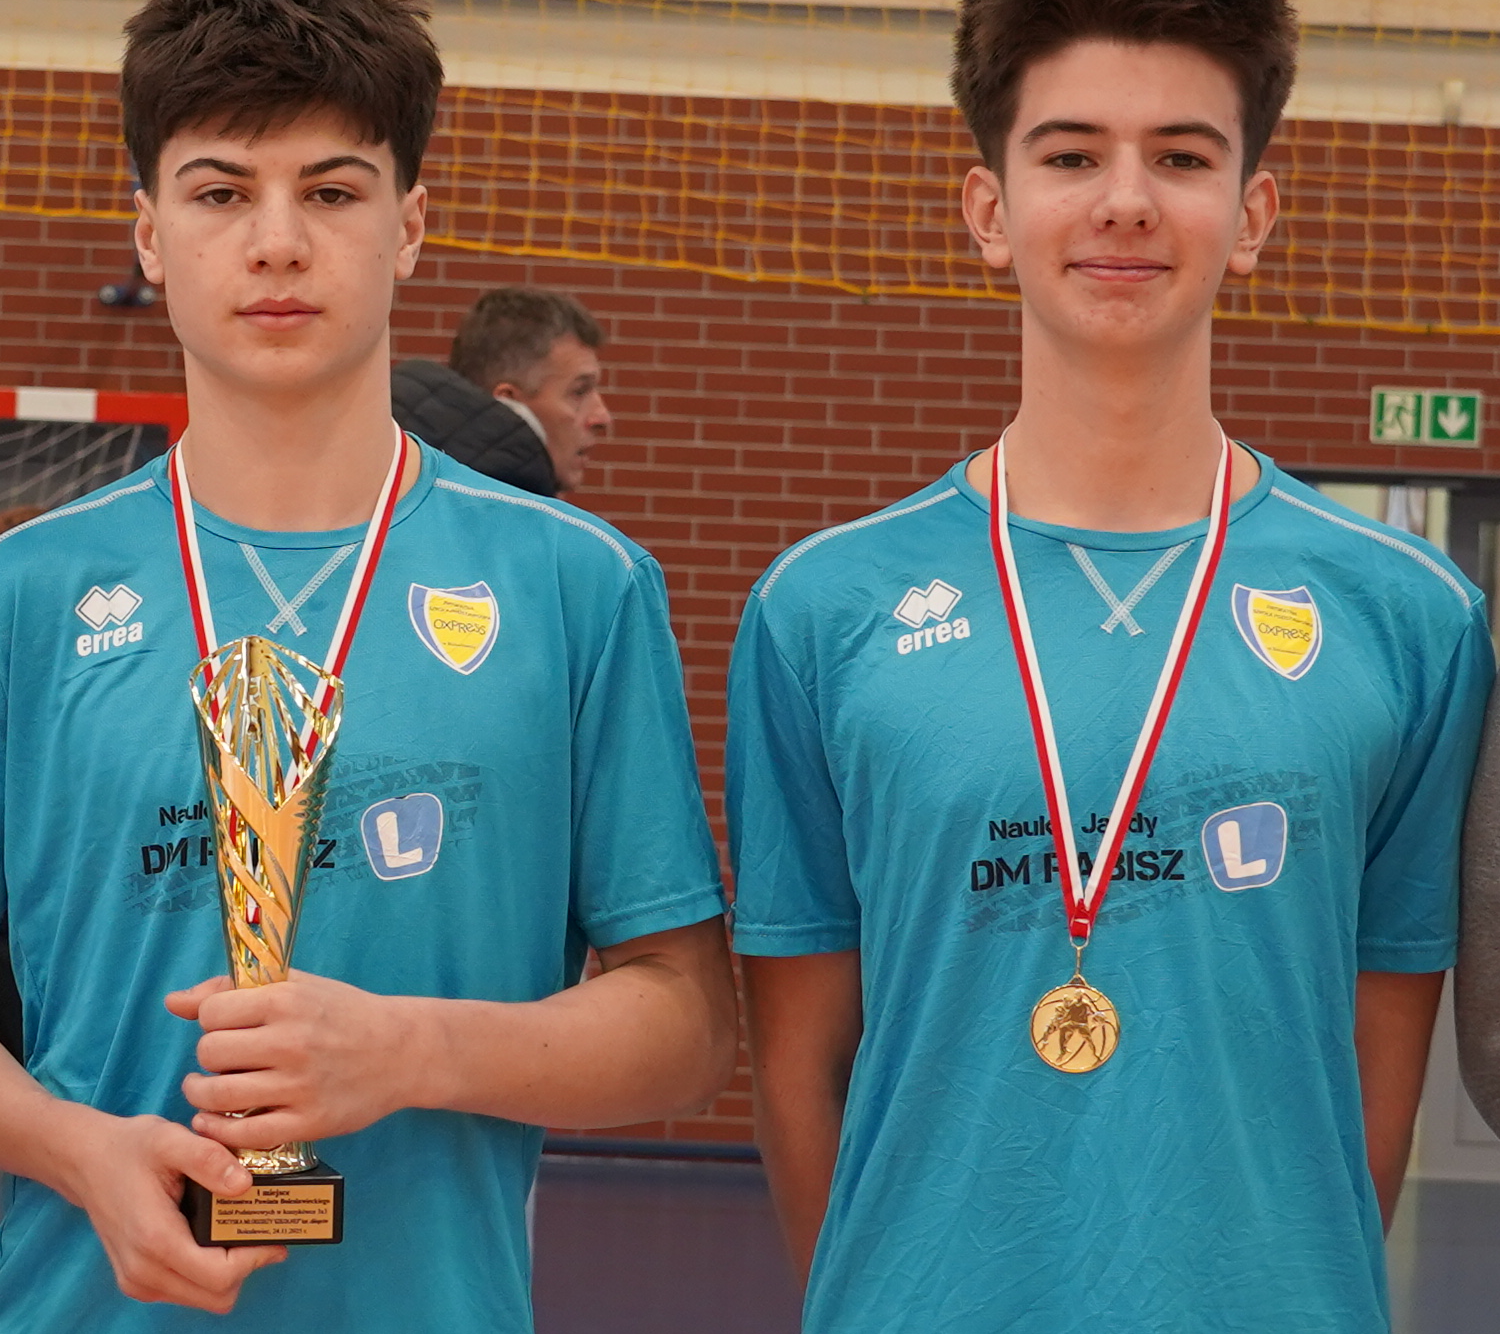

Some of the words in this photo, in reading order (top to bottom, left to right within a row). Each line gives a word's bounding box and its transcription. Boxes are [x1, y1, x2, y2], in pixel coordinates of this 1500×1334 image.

[989, 815, 1053, 841] Nauk
[1081, 813, 1158, 838] Jady
[971, 854, 1030, 892] DM
